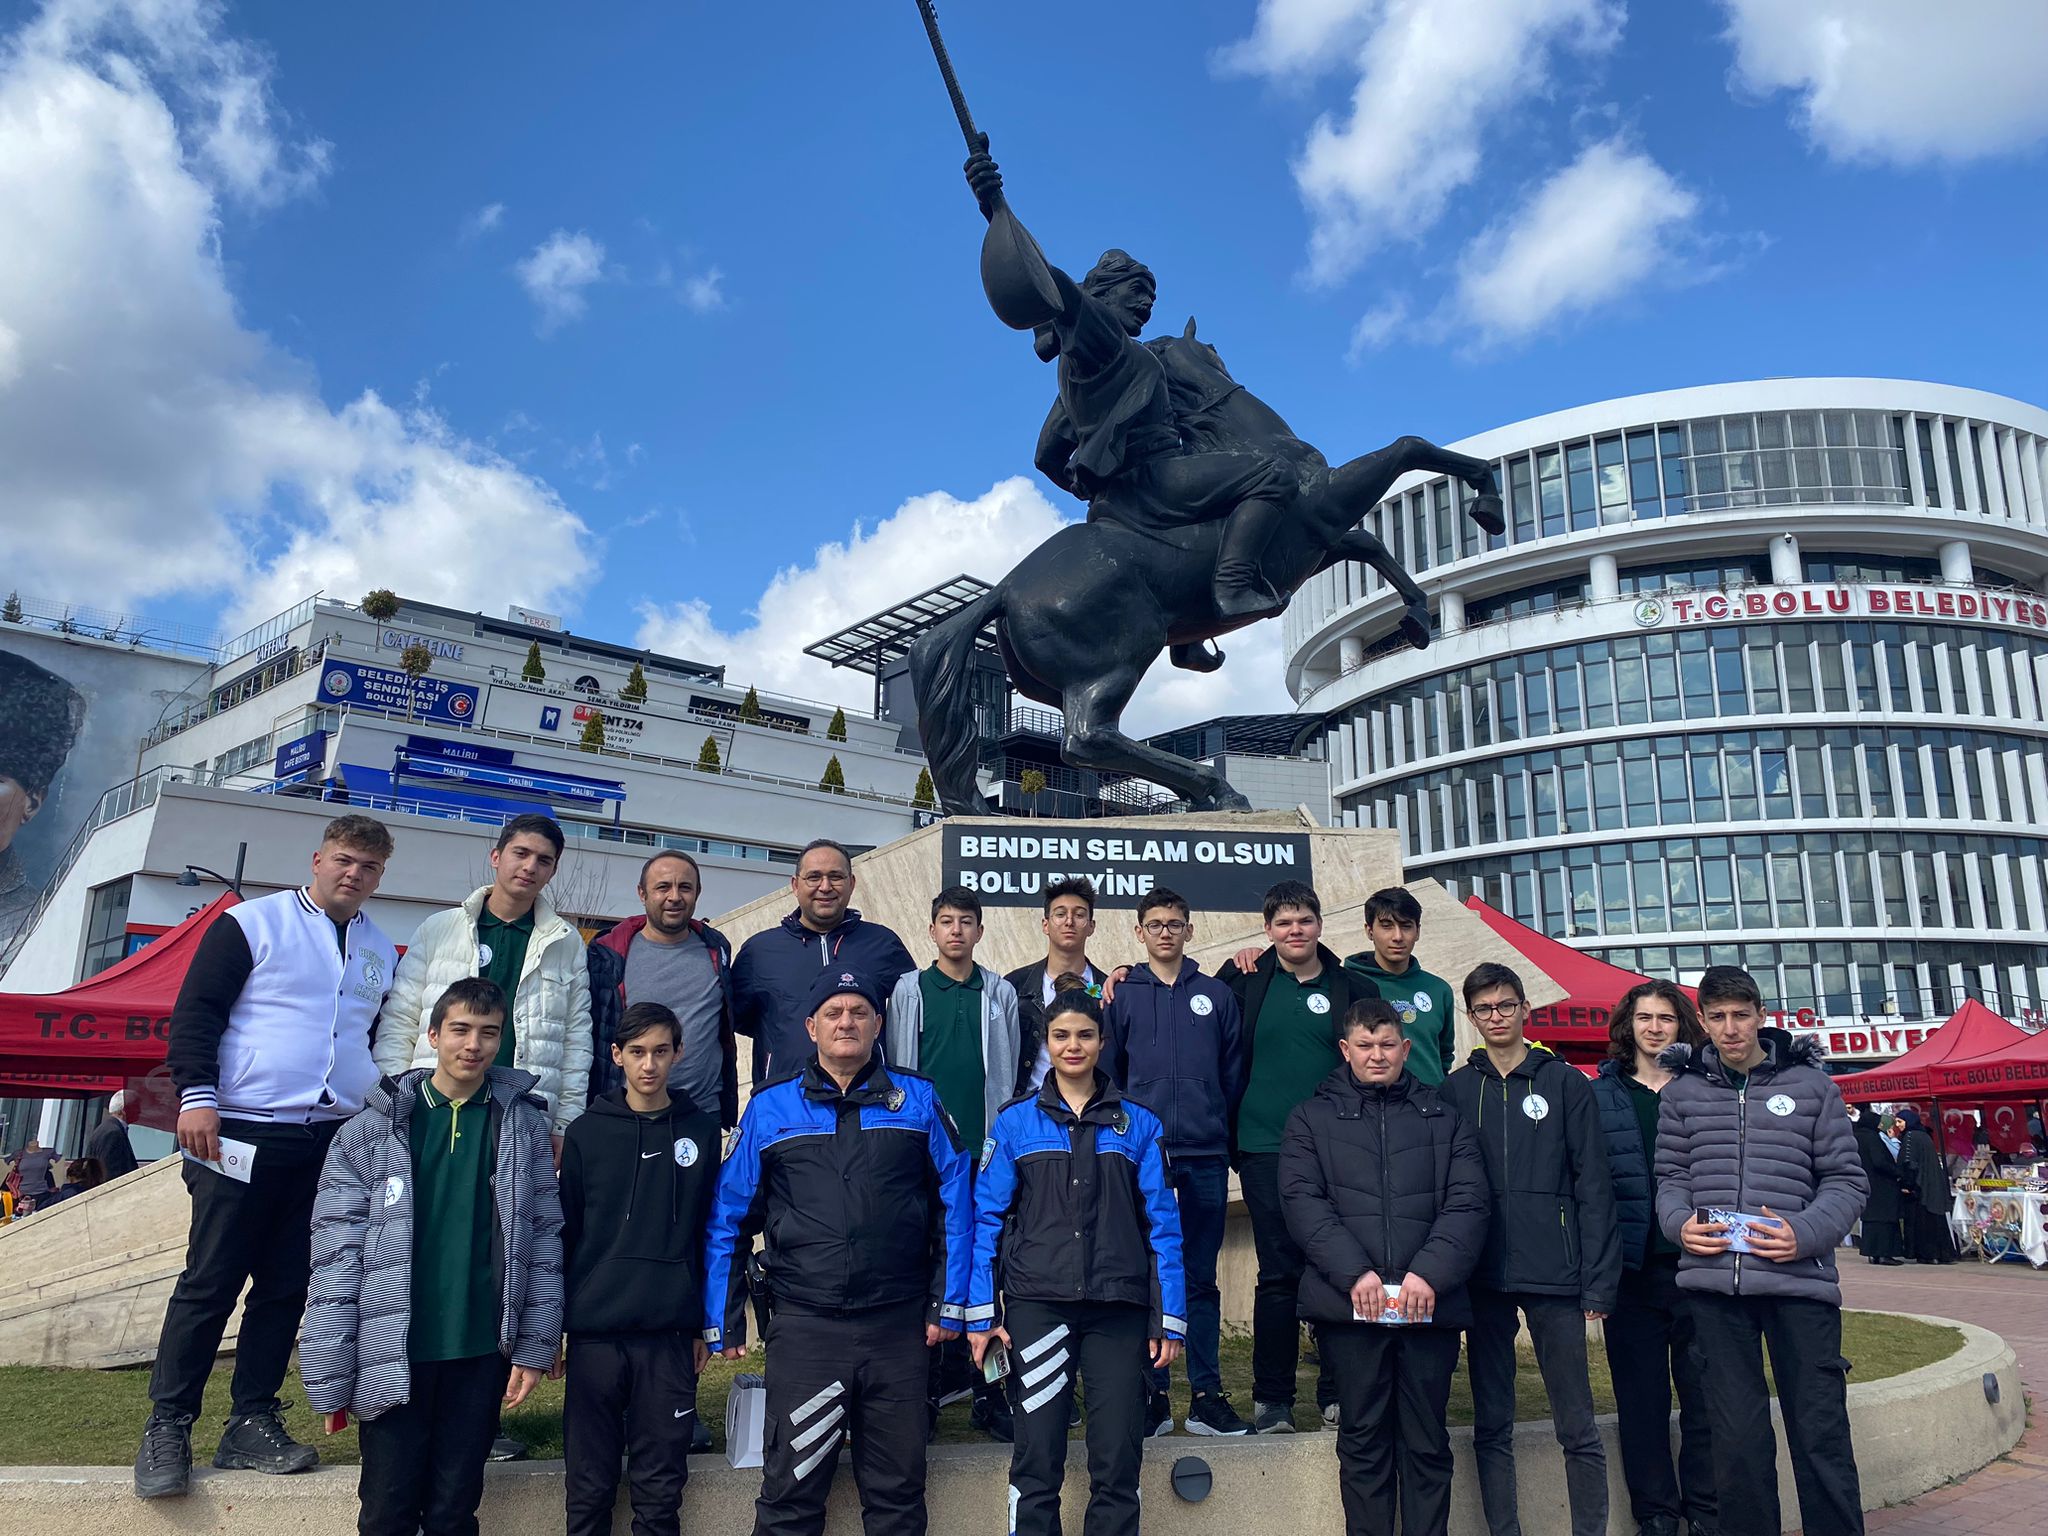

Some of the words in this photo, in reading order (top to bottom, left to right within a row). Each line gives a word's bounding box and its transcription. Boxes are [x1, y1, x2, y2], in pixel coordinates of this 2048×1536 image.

[1868, 589, 2047, 626] BELEDİYES
[255, 633, 290, 664] CAFFEINE
[383, 630, 464, 660] CAFFEINE
[366, 692, 394, 703] BOLU
[396, 697, 433, 711] ŞUESİ
[601, 714, 623, 727] ENT
[622, 718, 644, 731] 374
[960, 835, 1080, 860] BENDEN
[1087, 838, 1188, 863] SELAM
[1194, 841, 1295, 865] OLSUN
[960, 870, 1040, 894] BOLU
[1048, 868, 1154, 895] BYİNE
[34, 1012, 108, 1040] T.C.
[124, 1016, 171, 1041] BO
[1771, 1007, 1825, 1029] T.C.
[1967, 1069, 2001, 1085] BOLU
[2005, 1064, 2048, 1081] BELED
